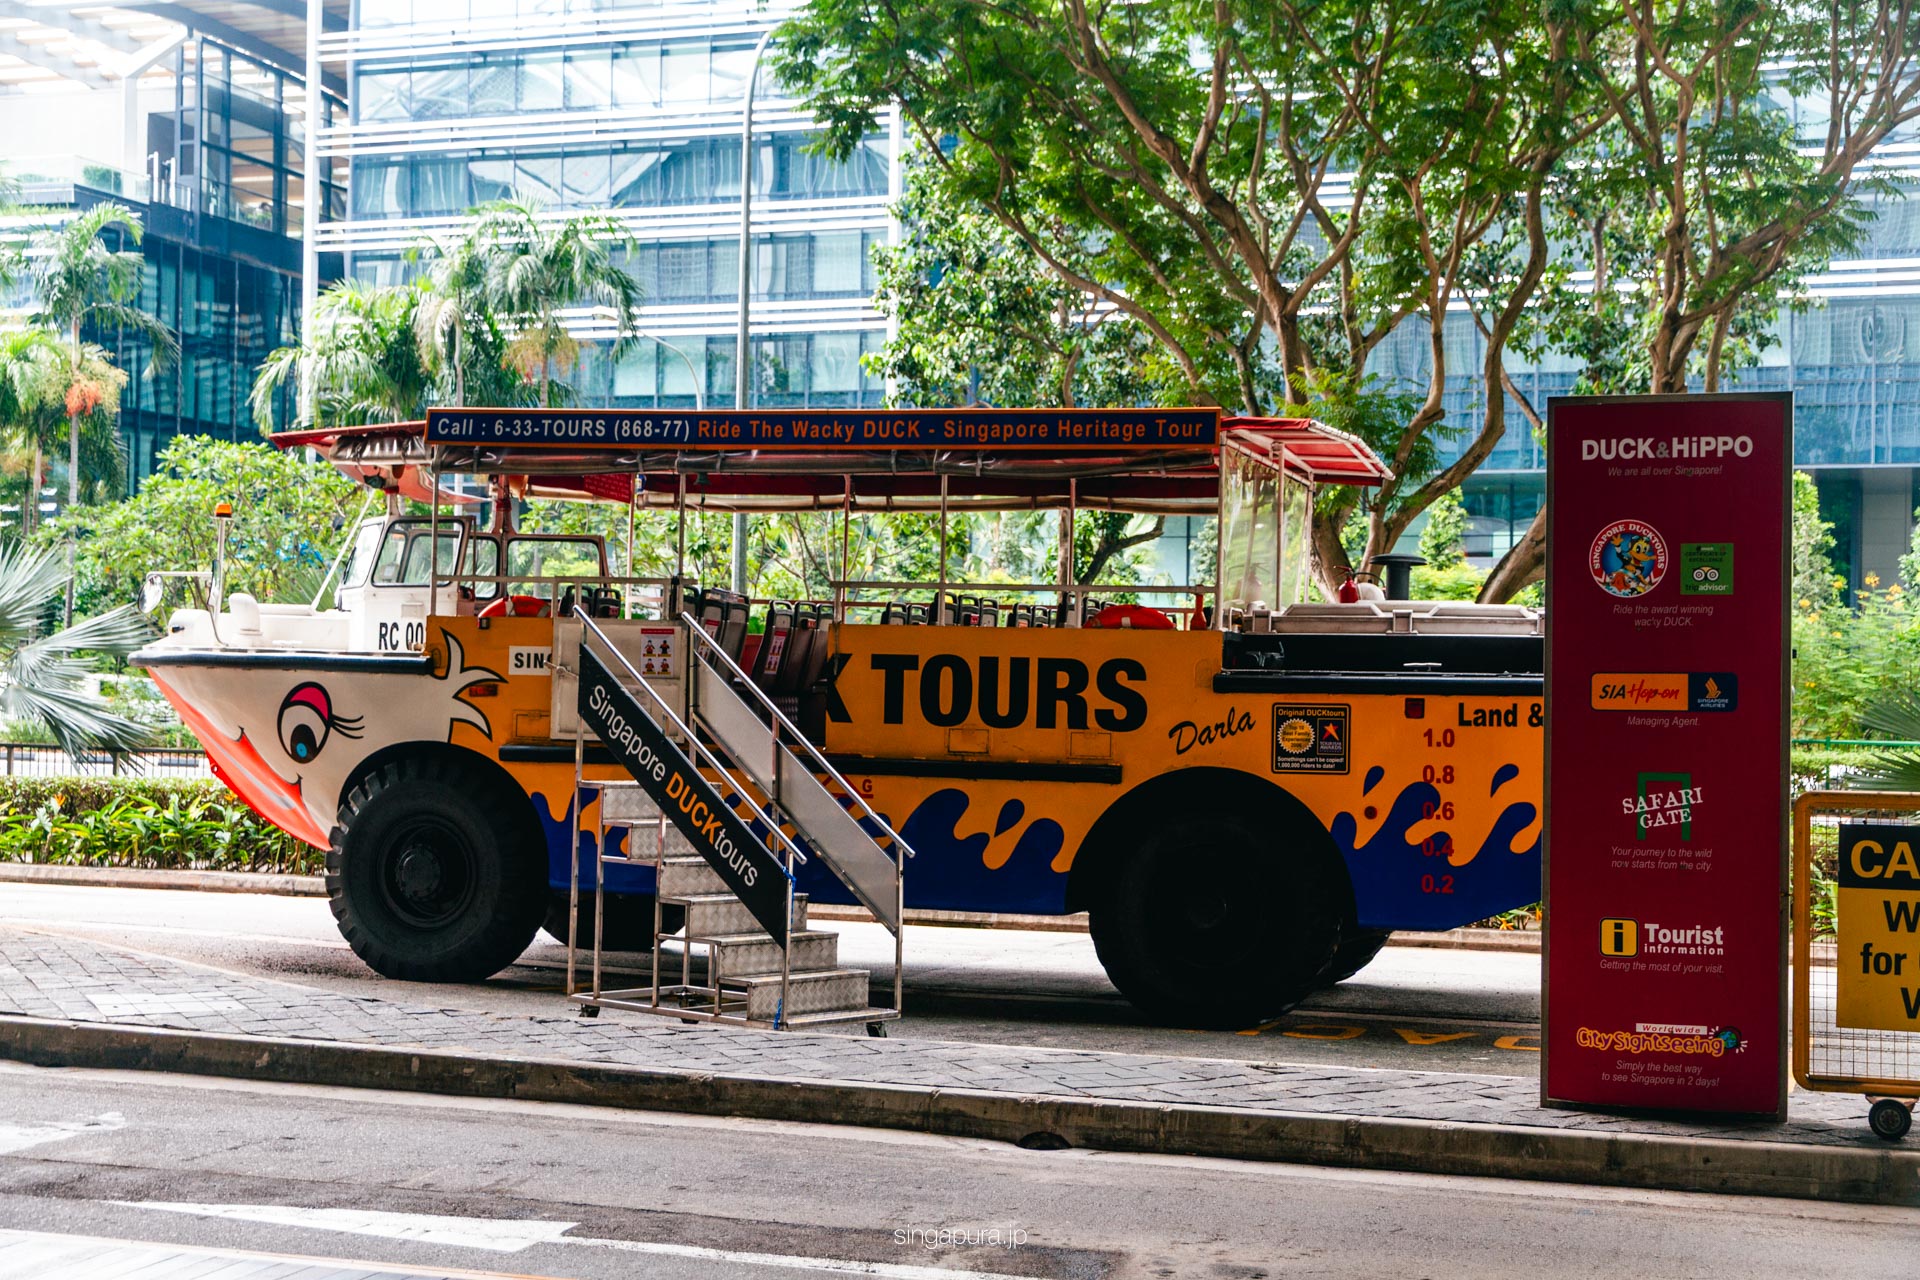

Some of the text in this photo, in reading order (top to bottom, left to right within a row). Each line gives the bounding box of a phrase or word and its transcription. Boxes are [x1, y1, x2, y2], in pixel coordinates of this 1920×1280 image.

[437, 417, 474, 436] Call
[494, 418, 606, 437] 6-33-TOURS
[613, 419, 690, 441] (868-77)
[698, 420, 742, 438] Ride
[749, 420, 784, 438] The
[792, 420, 855, 442] Wacky
[863, 420, 921, 438] DUCK
[944, 419, 1048, 442] Singapore
[1058, 419, 1146, 441] Heritage
[1155, 418, 1203, 438] Tour
[1608, 464, 1723, 477] We are all over Singapore!
[1593, 523, 1666, 569] SINGAPORE DUCKTOURS
[1685, 583, 1728, 593] tripadvisor
[1613, 604, 1714, 616] Ride the award winning
[1663, 616, 1694, 626] DUCK.
[378, 622, 399, 651] RC
[870, 653, 1148, 733] TOURS
[1598, 678, 1680, 704] SIA Hop-on
[1278, 708, 1345, 717] Original DUCKtours
[1458, 702, 1543, 727] Land &
[1627, 716, 1701, 728] Managing Agent.
[1168, 706, 1256, 755] Darla
[1423, 728, 1455, 747] 1.0
[1422, 765, 1455, 784] 0.8
[589, 685, 758, 887] Singapore DUCKtours
[862, 778, 873, 793] G
[1622, 786, 1703, 814] SAFARI
[1422, 801, 1455, 820] 0.6
[1639, 808, 1692, 828] GATE
[1421, 837, 1454, 857] 0.4
[1611, 846, 1712, 858] Your journey to the wild
[1611, 860, 1712, 872] now starts from the city.
[1421, 874, 1454, 894] 0.2
[1644, 923, 1724, 945] Tourist
[1644, 944, 1724, 955] information
[1600, 959, 1724, 974] Getting the most of your visit.
[1860, 943, 1907, 976] for
[1642, 1024, 1701, 1034] Worldwide
[1616, 1060, 1703, 1075] Simply the best way
[1601, 1072, 1720, 1088] to see Singapore in 2 days!
